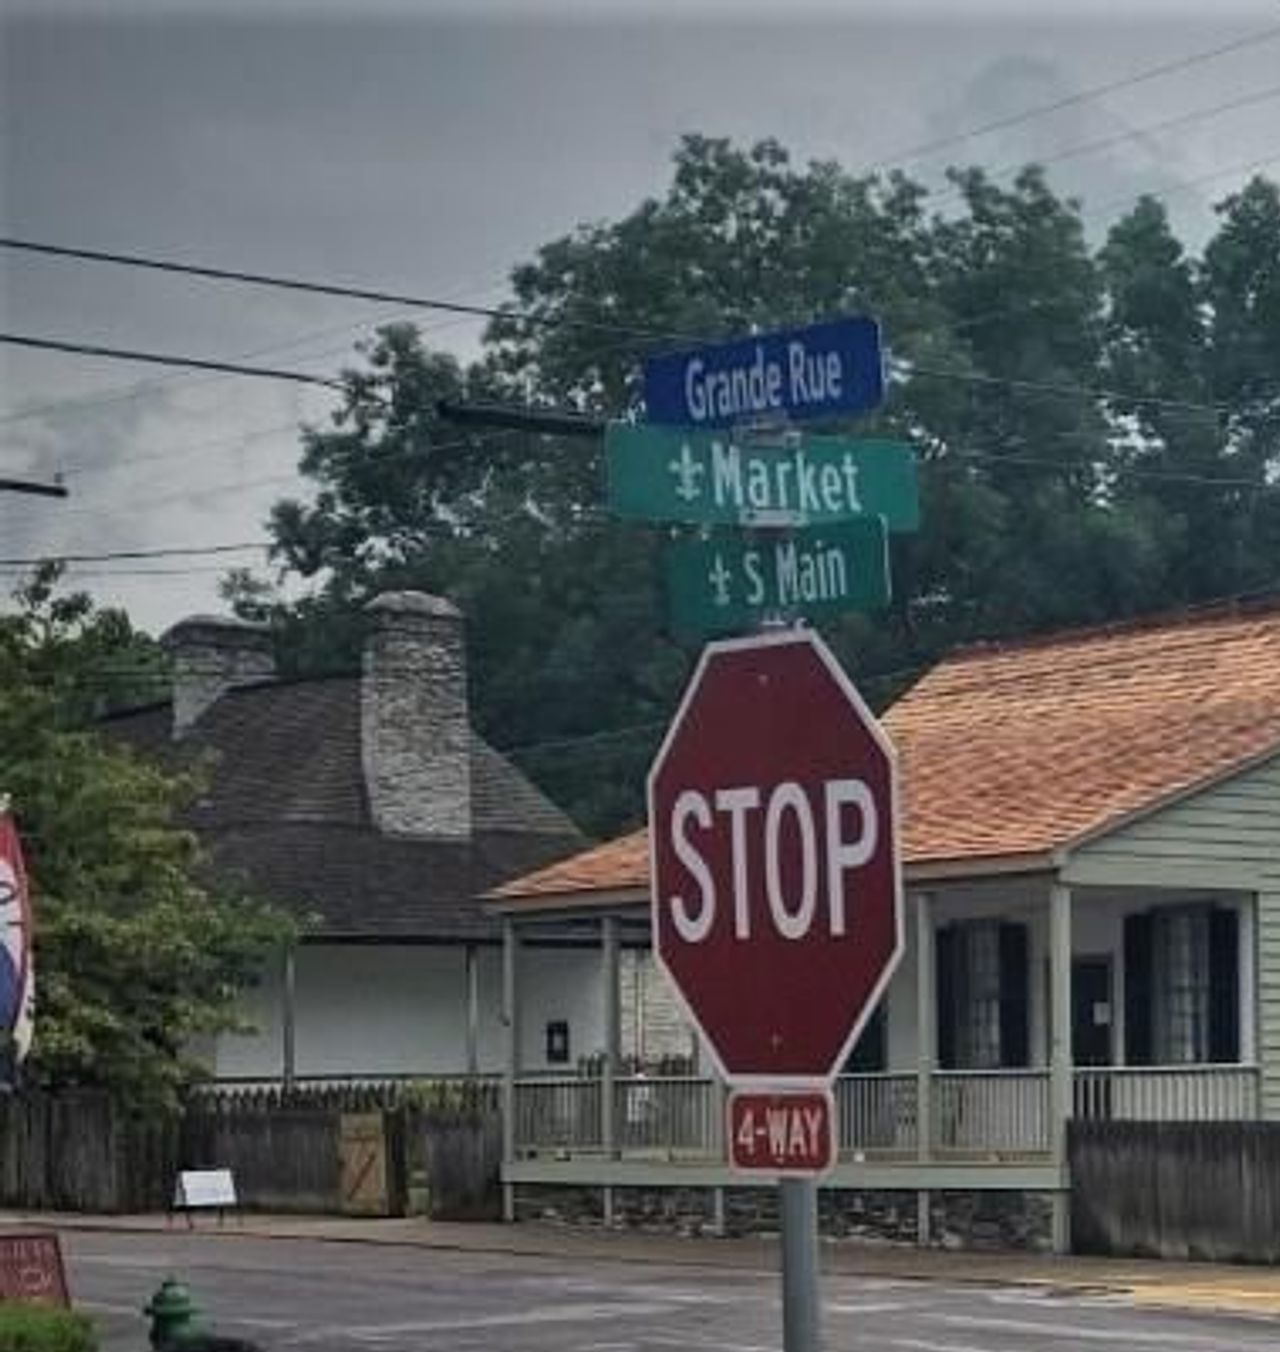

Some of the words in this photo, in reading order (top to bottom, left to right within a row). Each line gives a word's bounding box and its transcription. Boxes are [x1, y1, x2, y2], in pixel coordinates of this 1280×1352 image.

[685, 345, 781, 420] Grande
[789, 343, 842, 402] Rue
[712, 443, 862, 512] Market
[743, 551, 766, 605] S
[776, 539, 847, 606] Main
[671, 779, 876, 943] STOP
[737, 1105, 824, 1158] 4-WAY
